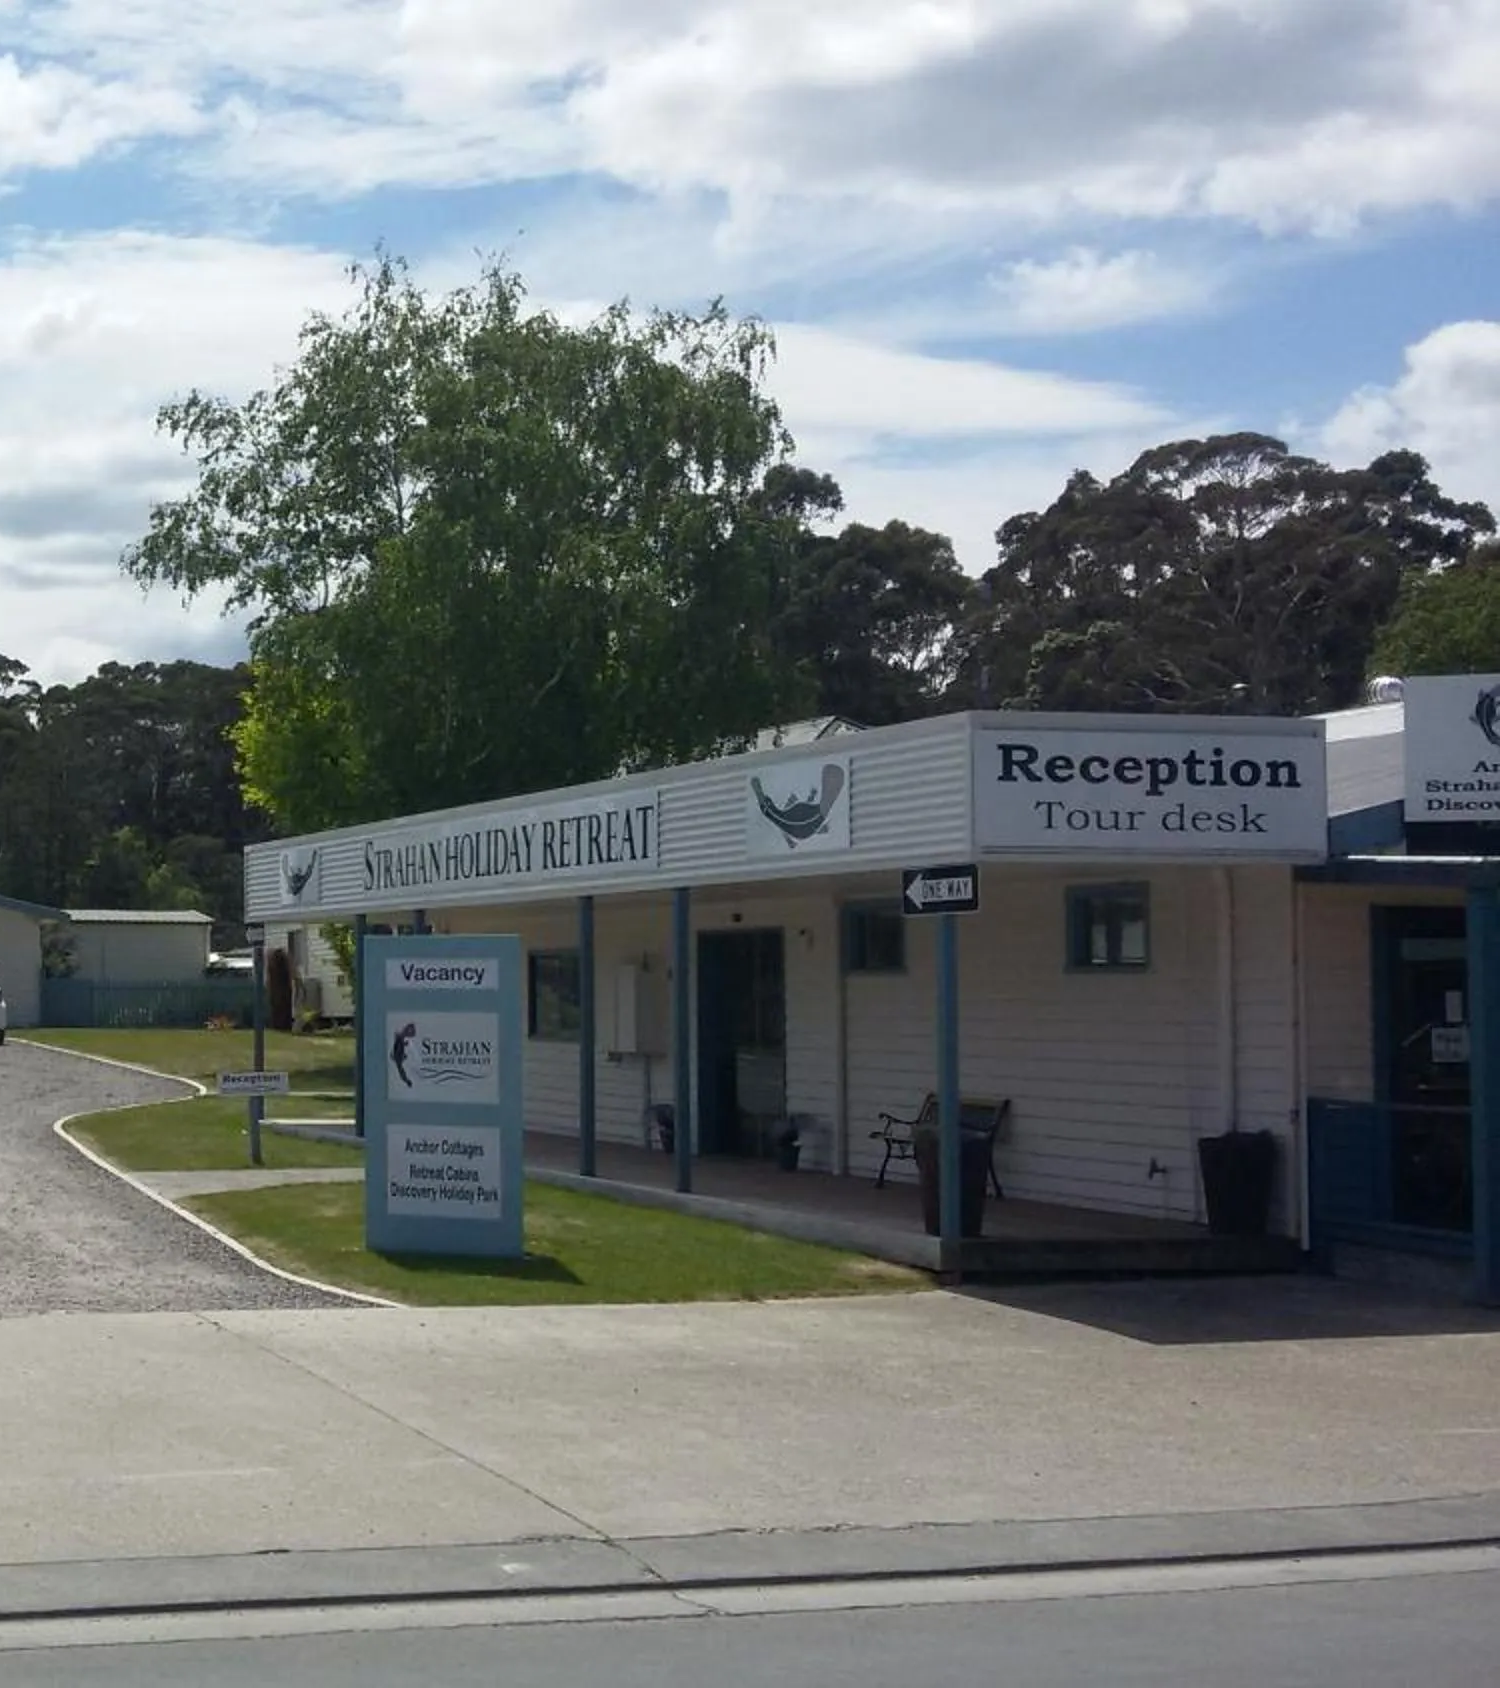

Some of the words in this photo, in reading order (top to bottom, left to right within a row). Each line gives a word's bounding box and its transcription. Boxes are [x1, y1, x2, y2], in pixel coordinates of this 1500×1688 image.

[996, 743, 1302, 796] Reception
[1034, 801, 1146, 831] Tour
[1161, 803, 1268, 833] desk
[363, 841, 442, 890] STRAHAN
[445, 823, 537, 882] HOLIDAY
[542, 805, 655, 870] RETREAT
[923, 880, 944, 899] ONE
[946, 879, 970, 897] WAY
[401, 963, 485, 985] Vacancy
